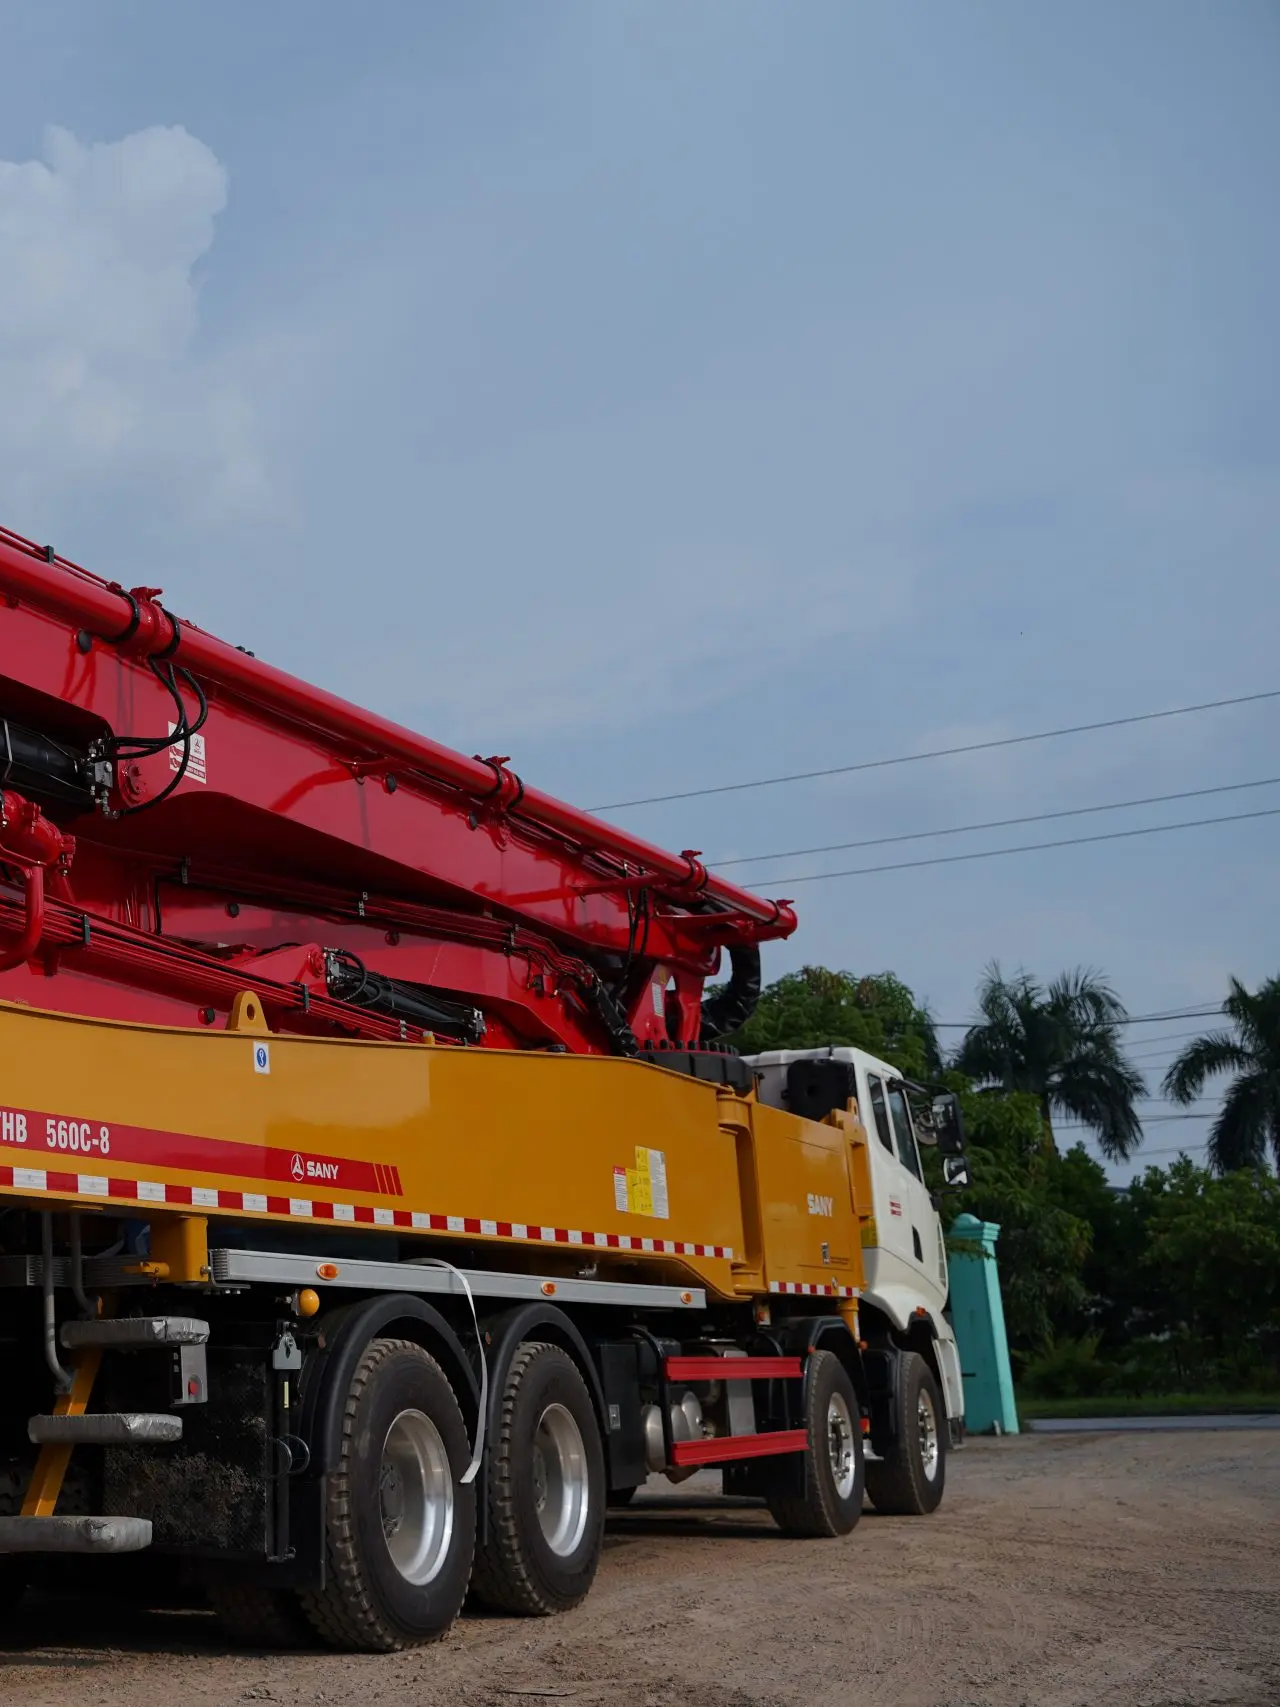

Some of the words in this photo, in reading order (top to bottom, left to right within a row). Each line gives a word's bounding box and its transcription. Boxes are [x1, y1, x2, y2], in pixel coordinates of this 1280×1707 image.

[46, 1118, 110, 1154] 560C-8
[306, 1160, 339, 1180] SANY
[806, 1193, 833, 1217] SANY
